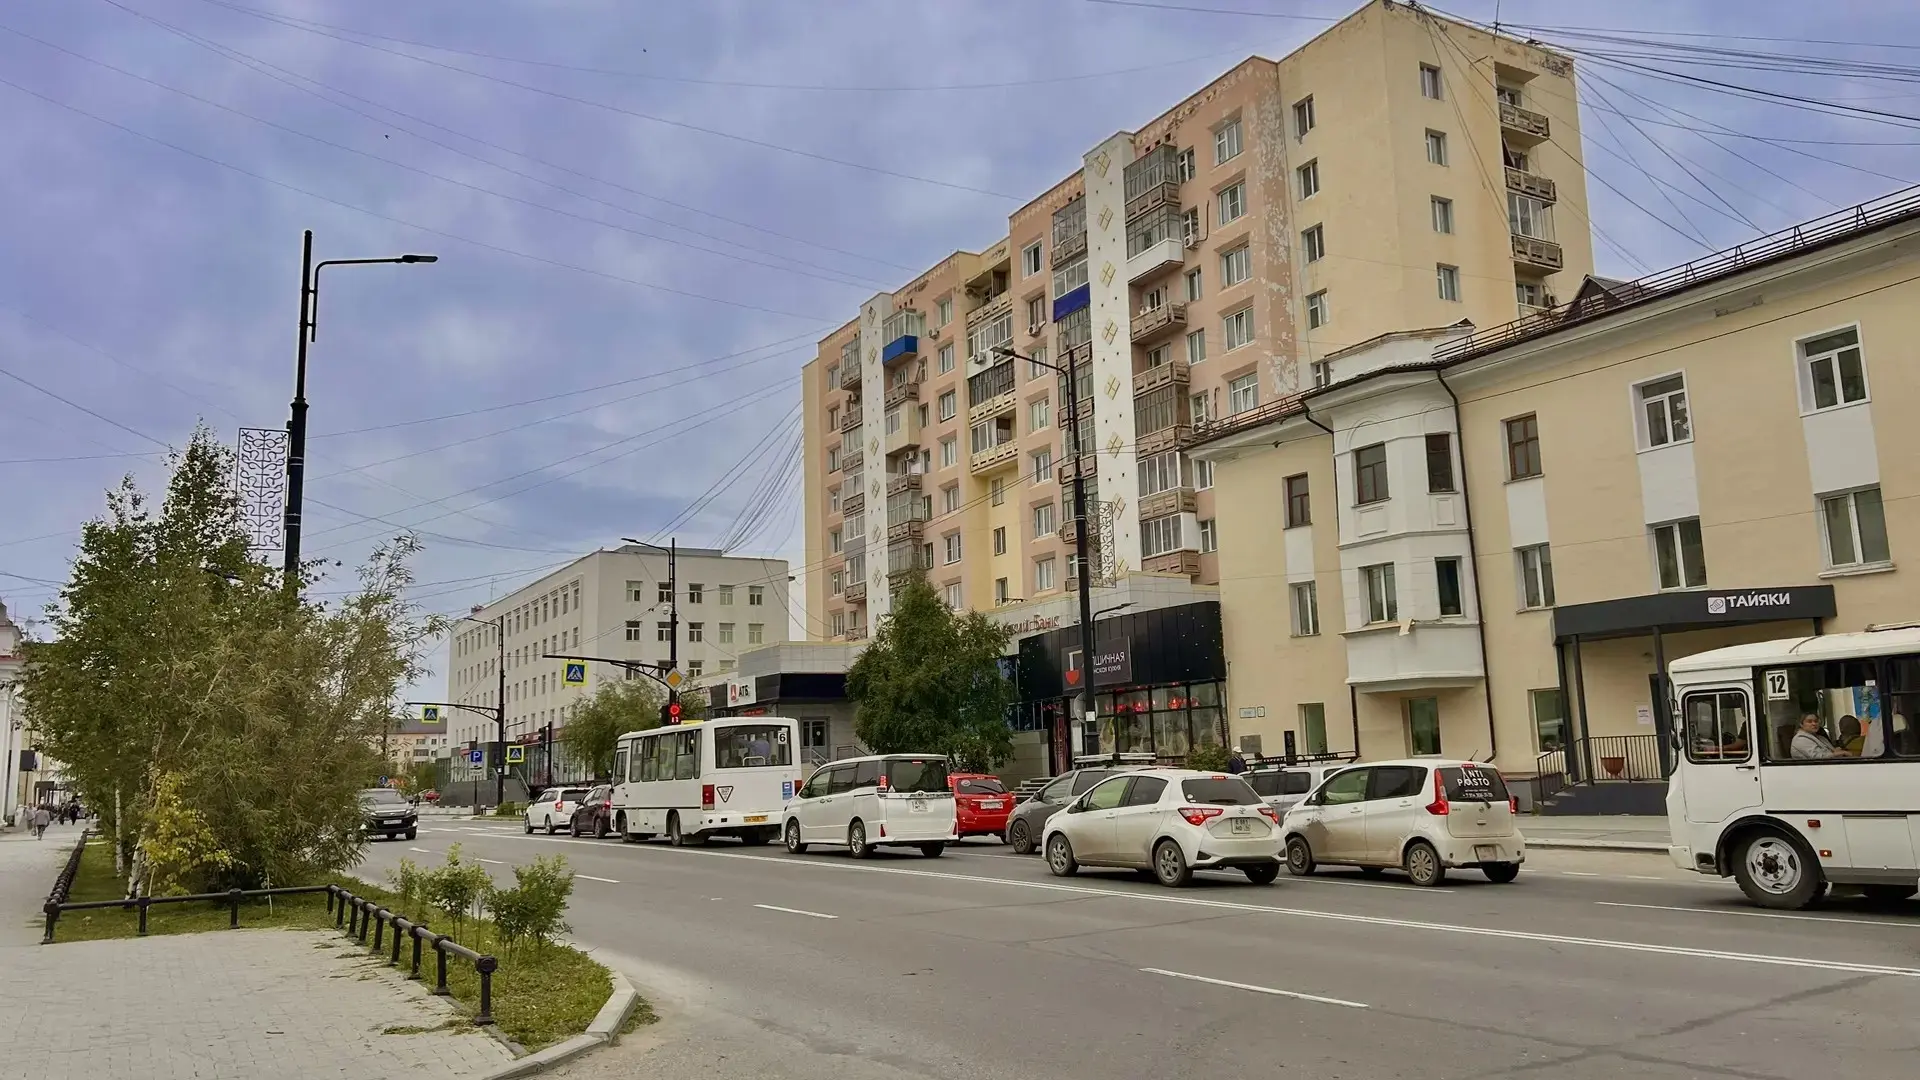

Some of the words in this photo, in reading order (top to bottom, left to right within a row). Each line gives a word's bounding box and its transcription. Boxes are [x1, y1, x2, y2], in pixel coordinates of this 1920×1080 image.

[1726, 591, 1790, 608] ТАЙЯКИ
[739, 684, 749, 697] АТБ
[1769, 675, 1786, 693] 12
[779, 733, 786, 742] 6
